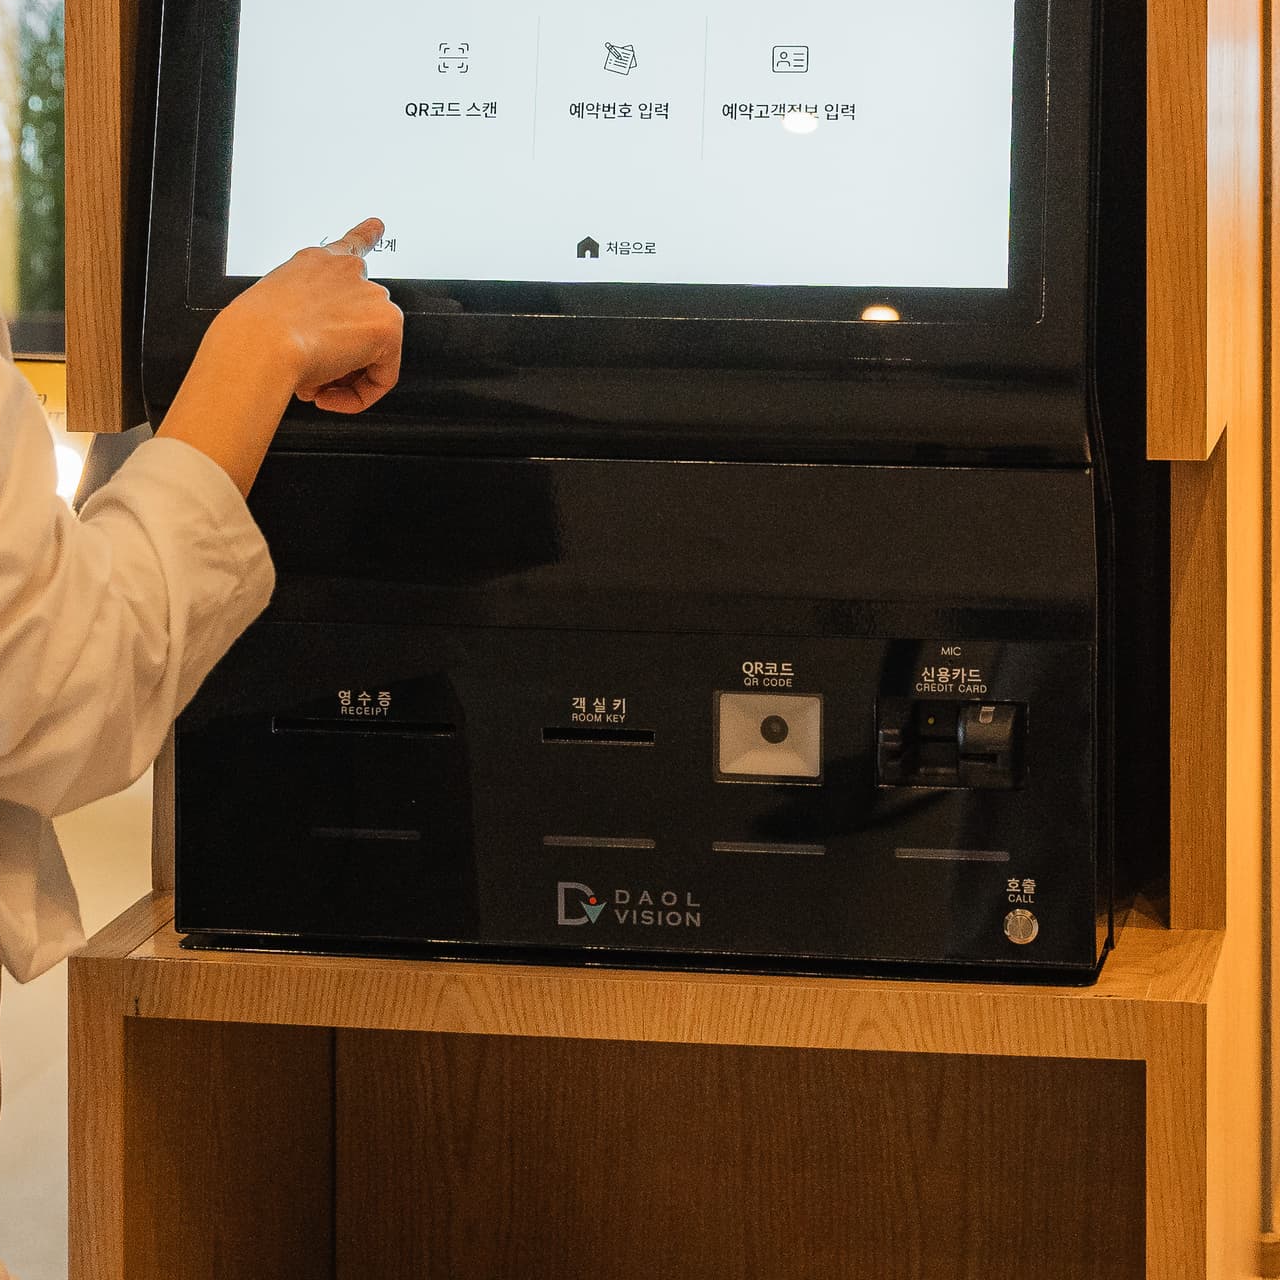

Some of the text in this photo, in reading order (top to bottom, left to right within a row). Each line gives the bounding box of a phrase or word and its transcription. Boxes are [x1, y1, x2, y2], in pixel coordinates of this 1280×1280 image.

[405, 101, 498, 119] QR코드 스캔
[569, 101, 670, 120] 예약번호 입력
[824, 103, 856, 121] 입력
[606, 241, 657, 256] 처음으로
[940, 646, 962, 657] MIC
[742, 661, 795, 677] QR코드
[921, 666, 982, 684] 신용카드
[743, 677, 793, 688] QR CODE
[915, 682, 988, 694] CREDIT CARD
[340, 705, 389, 717] RECEIPT
[571, 713, 626, 724] ROOM KEY
[1005, 877, 1037, 895] 호출
[614, 889, 701, 908] DAOL
[1007, 893, 1036, 904] CALL
[613, 908, 702, 928] VISION
